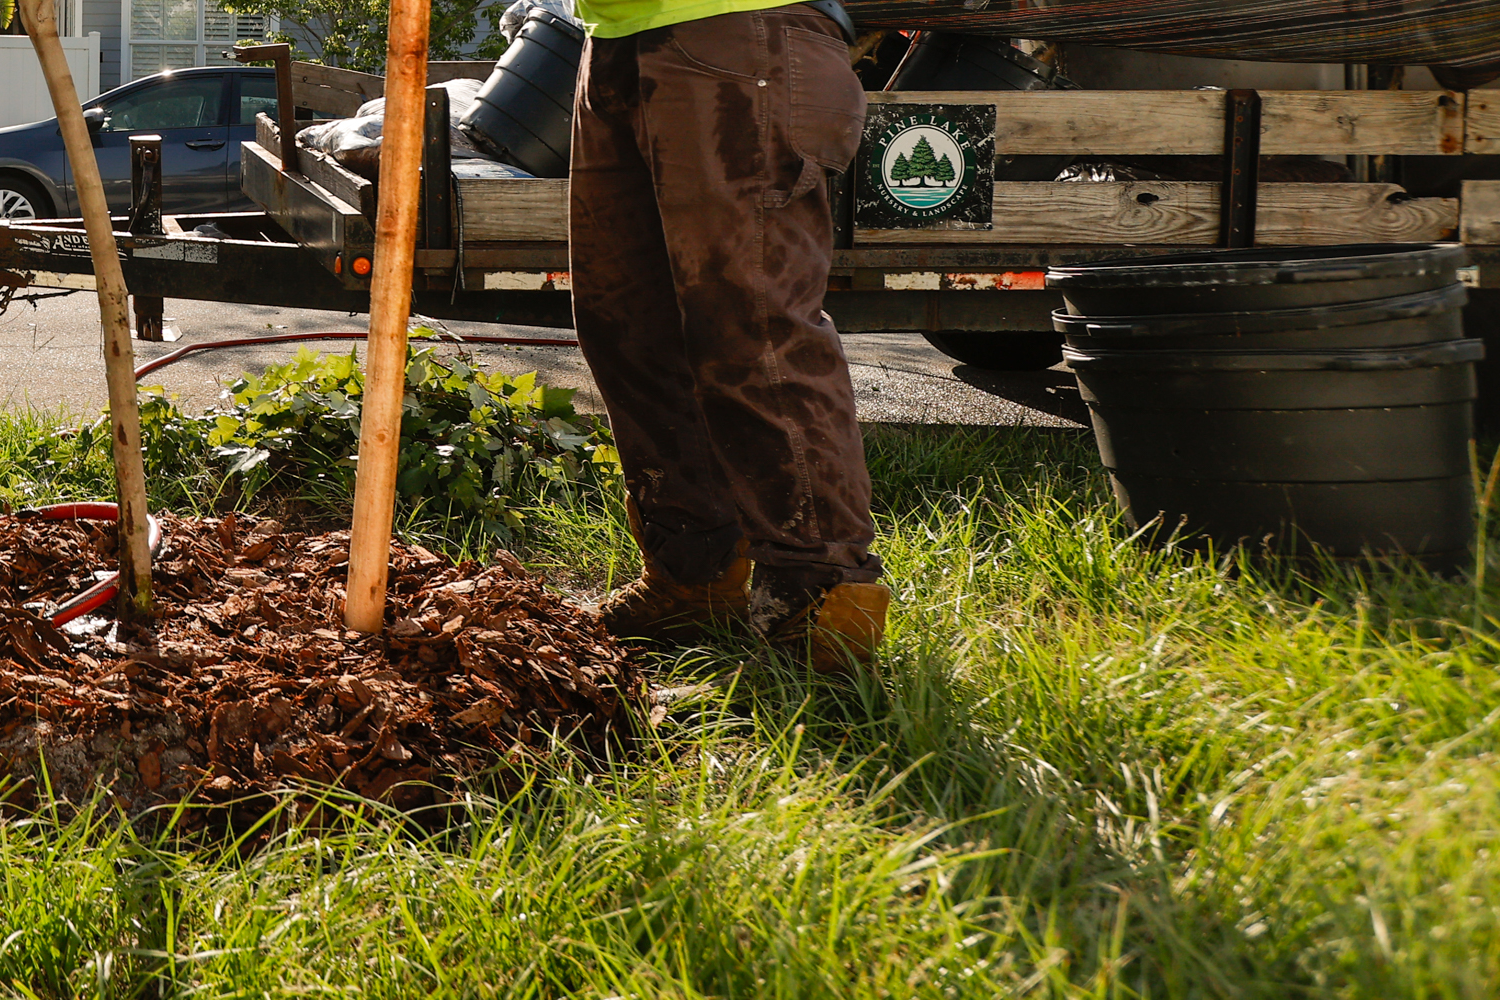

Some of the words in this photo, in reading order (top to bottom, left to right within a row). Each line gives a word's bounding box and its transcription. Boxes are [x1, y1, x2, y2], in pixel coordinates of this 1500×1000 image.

[878, 115, 918, 147] PINE
[929, 115, 971, 151] LAKE
[876, 183, 909, 214] NURSERY
[922, 184, 969, 217] LANDSCAPE
